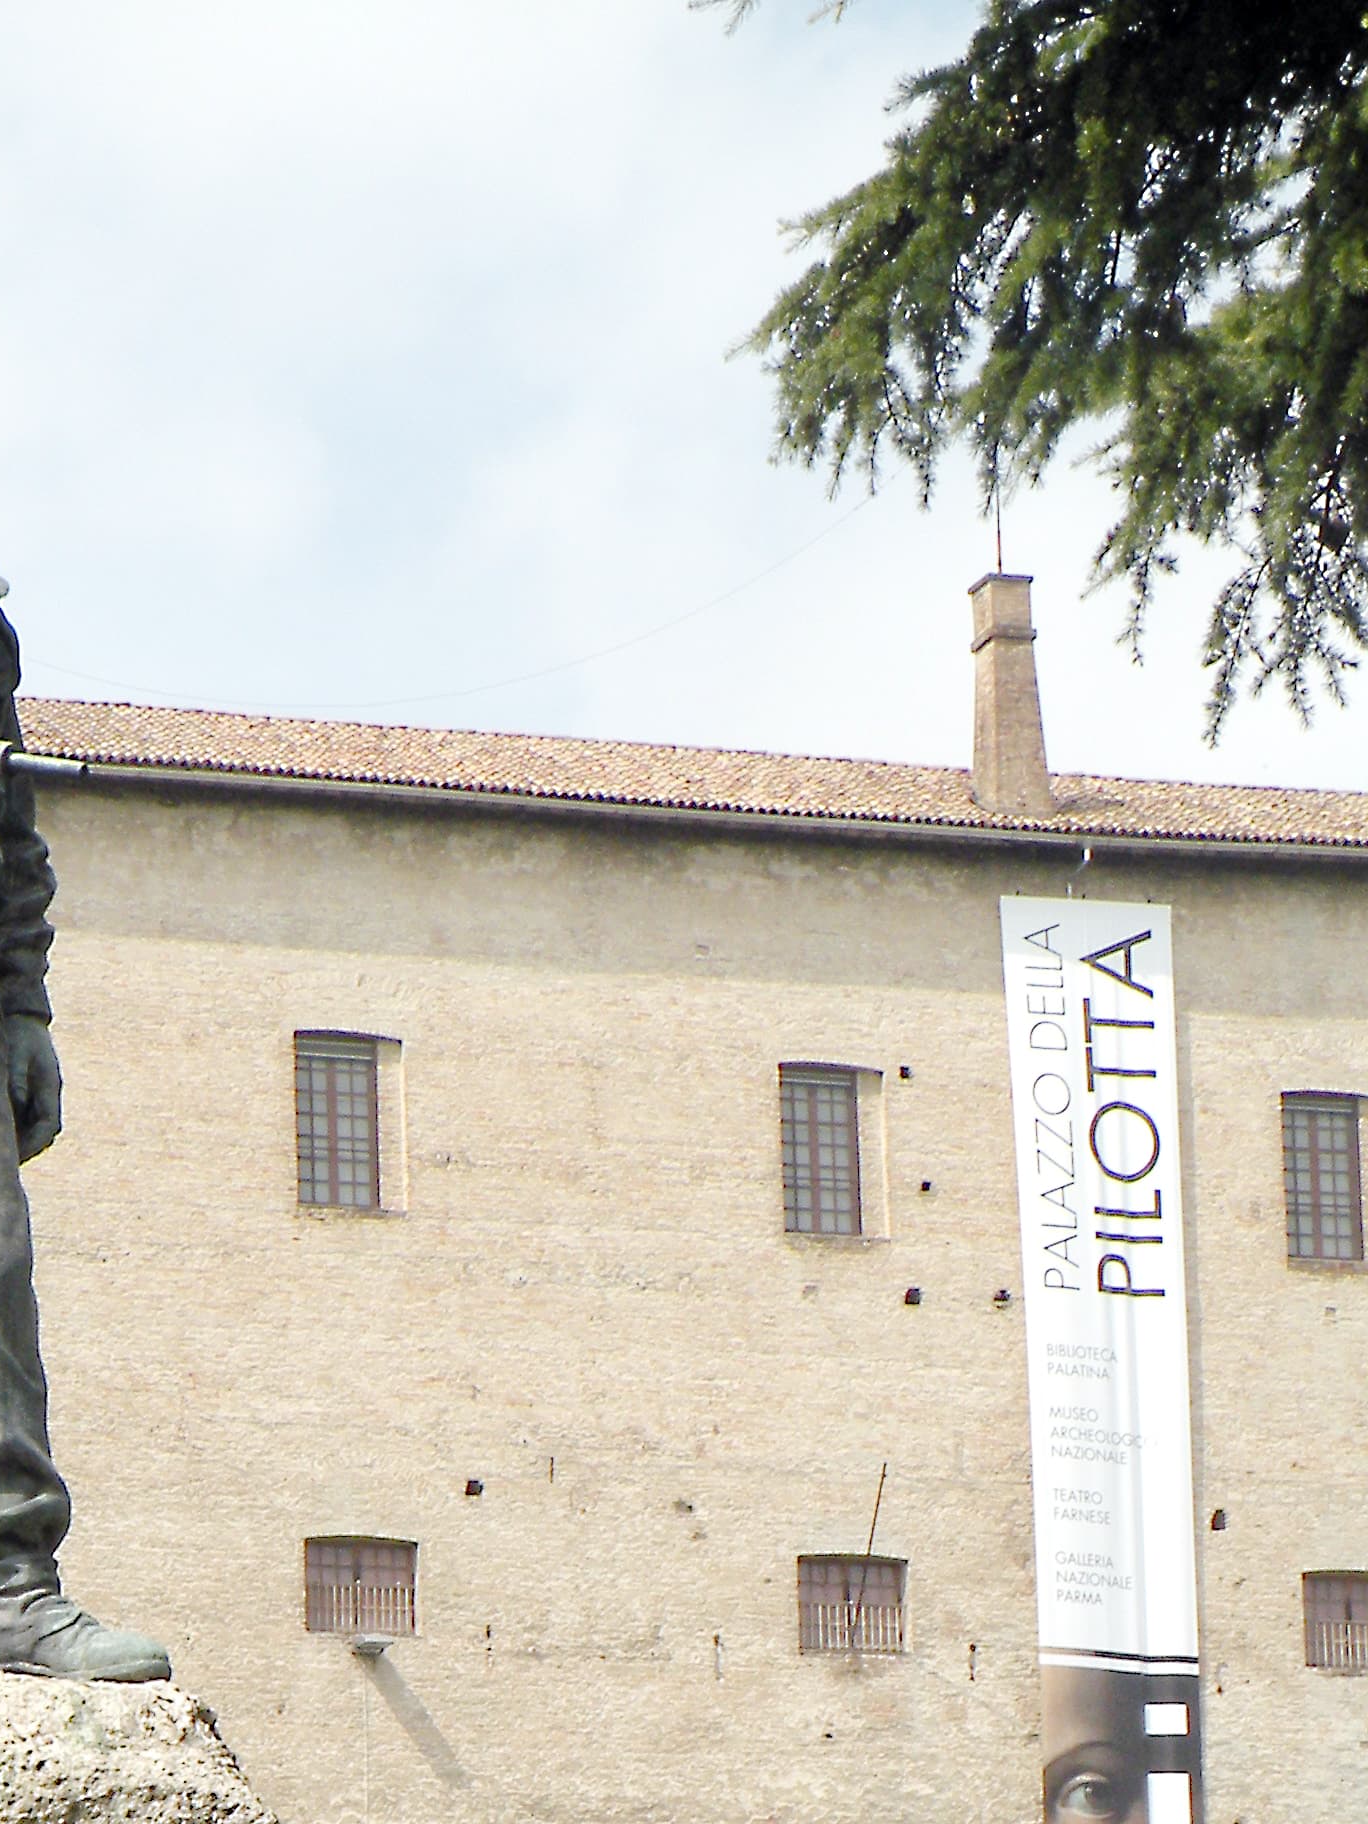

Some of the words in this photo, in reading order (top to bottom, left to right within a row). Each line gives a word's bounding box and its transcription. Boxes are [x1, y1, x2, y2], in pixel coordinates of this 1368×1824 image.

[1023, 923, 1068, 1051] DELLA
[1080, 930, 1165, 1297] PILOTTA
[1033, 1072, 1080, 1290] PALAZZO
[1046, 1343, 1117, 1363] BIBLIOTECA
[1047, 1362, 1110, 1380] PALATINA
[1049, 1406, 1099, 1423] MUSEO
[1051, 1446, 1128, 1465] NAZIONALE
[1053, 1488, 1103, 1506] TEATRO
[1054, 1507, 1111, 1525] FARNESE
[1055, 1551, 1114, 1569] GALLERIA
[1056, 1570, 1133, 1590] NAZIONALE
[1057, 1589, 1103, 1606] PARMA
